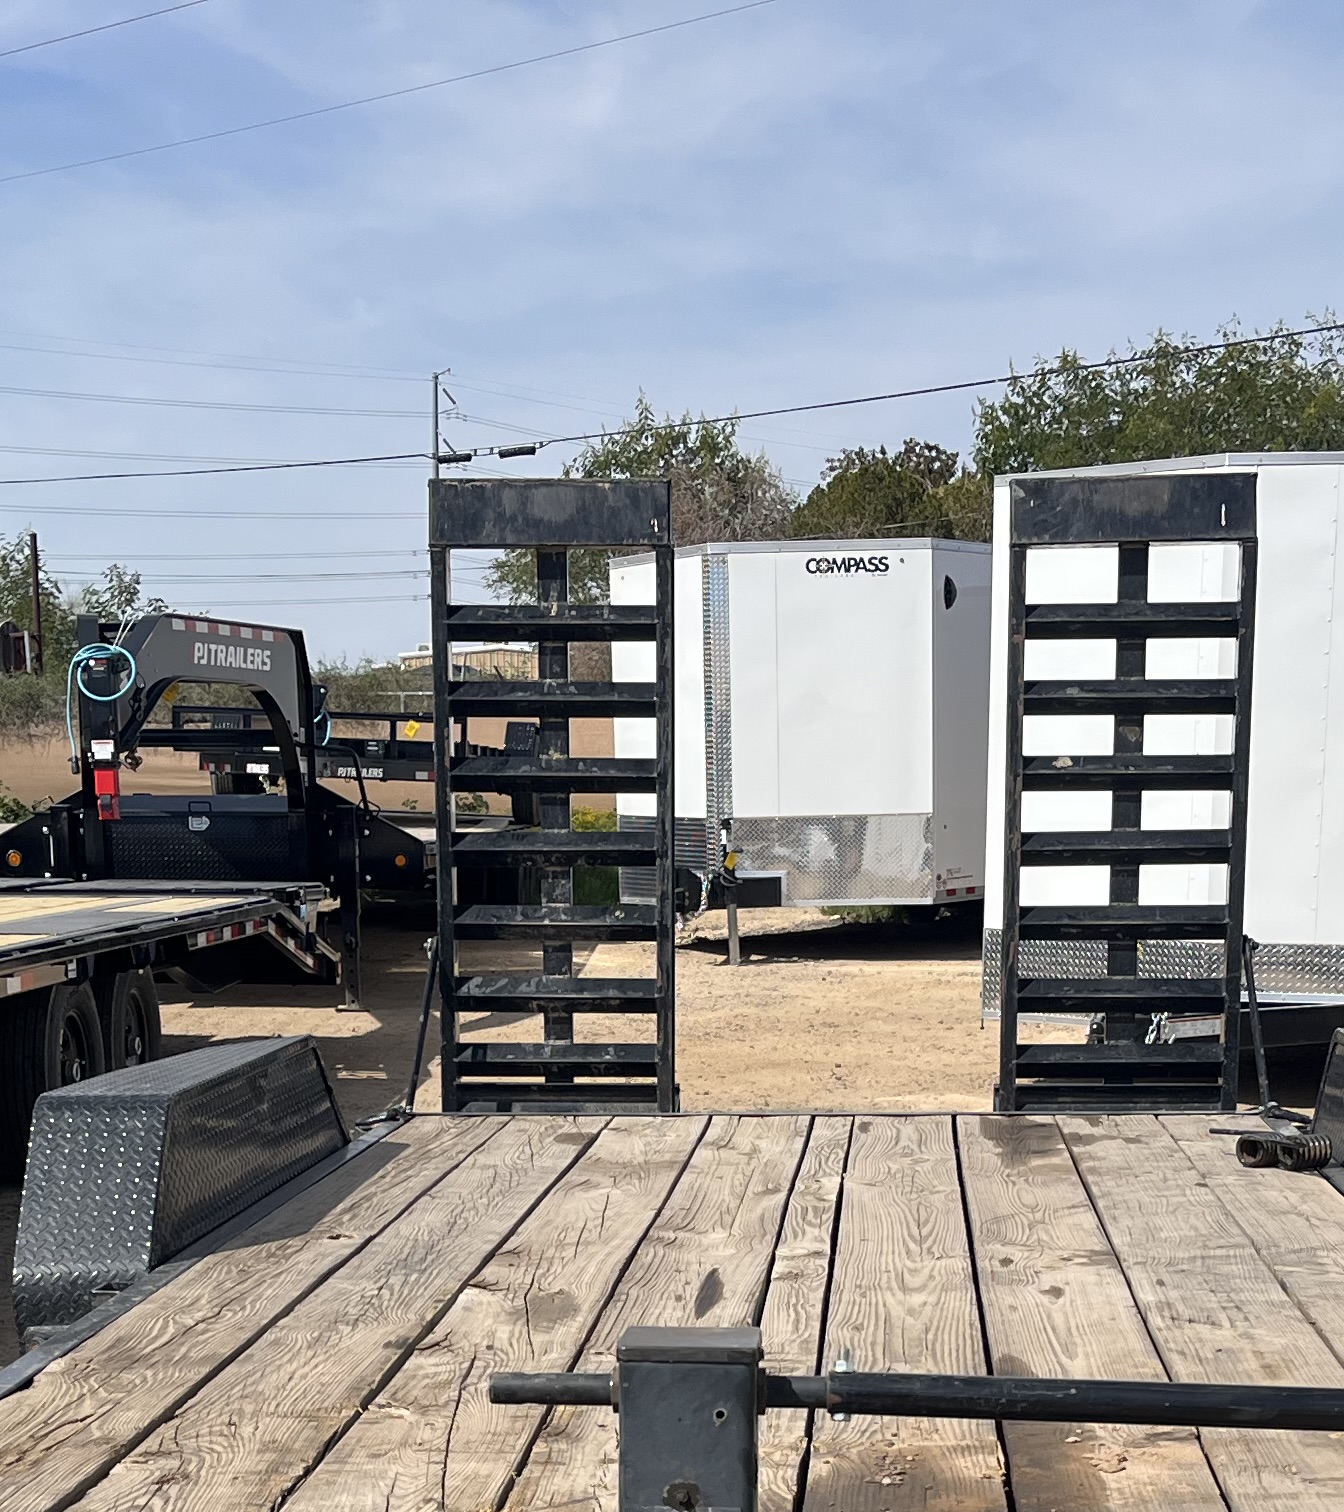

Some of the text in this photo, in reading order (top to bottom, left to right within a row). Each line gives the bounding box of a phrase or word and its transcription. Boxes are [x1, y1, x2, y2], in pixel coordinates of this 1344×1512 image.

[805, 556, 890, 574] COMPASS
[193, 642, 271, 671] PJ TRAILERS
